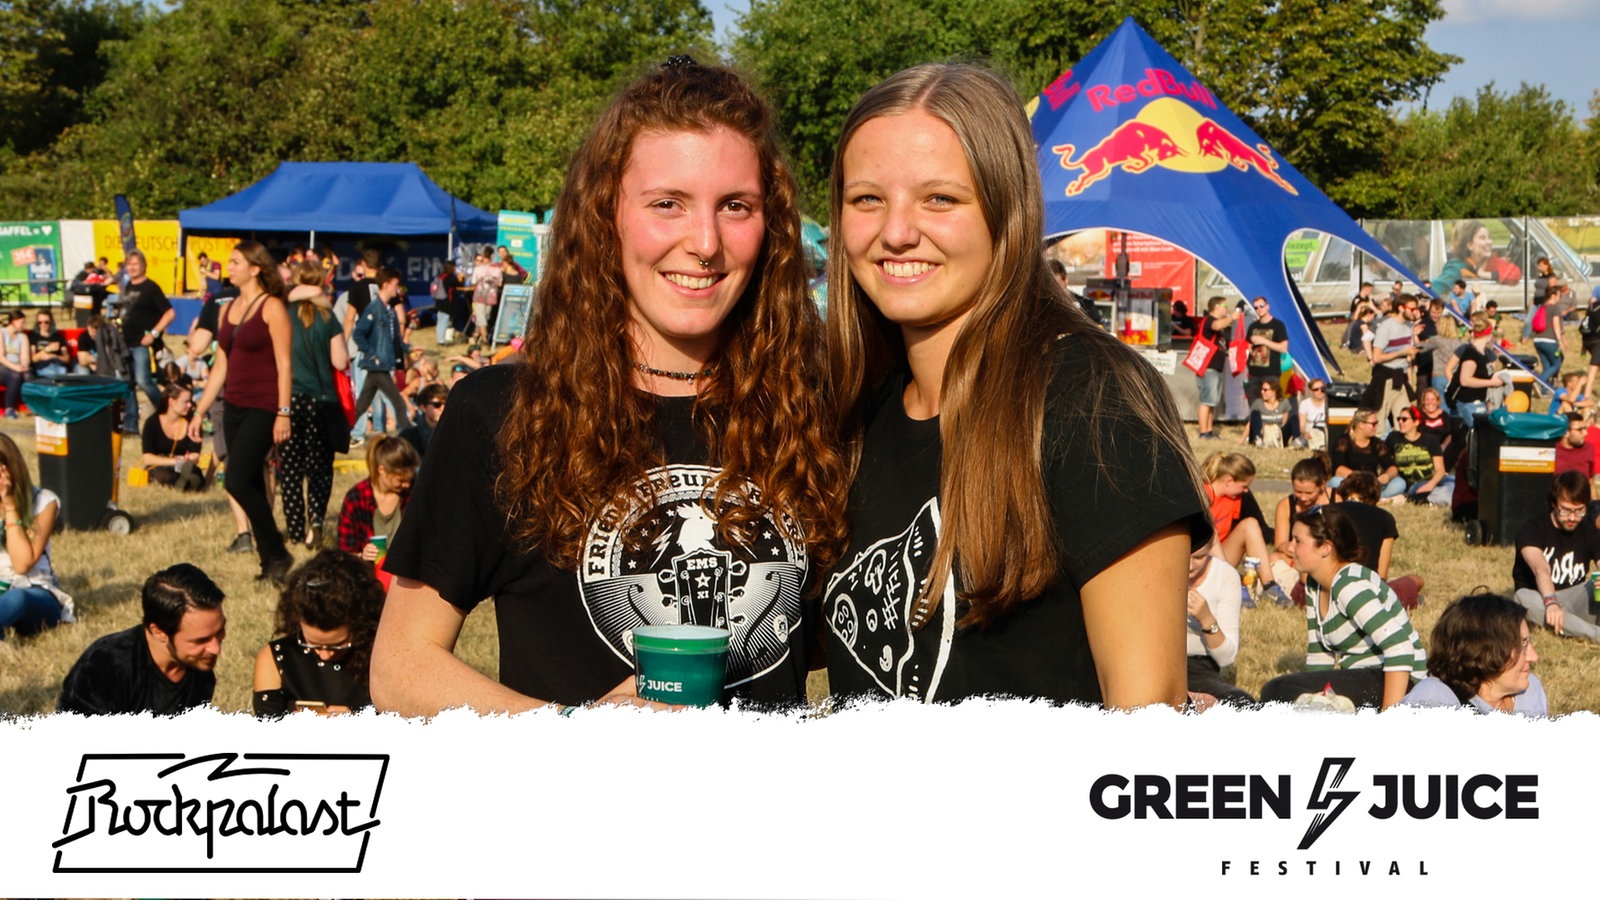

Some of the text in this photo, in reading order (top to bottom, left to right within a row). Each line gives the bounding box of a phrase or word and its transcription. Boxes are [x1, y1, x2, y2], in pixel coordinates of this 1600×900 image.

[0, 225, 32, 236] AFFEL
[686, 556, 718, 570] EMS
[697, 590, 709, 599] XI
[647, 679, 683, 692] JUICE
